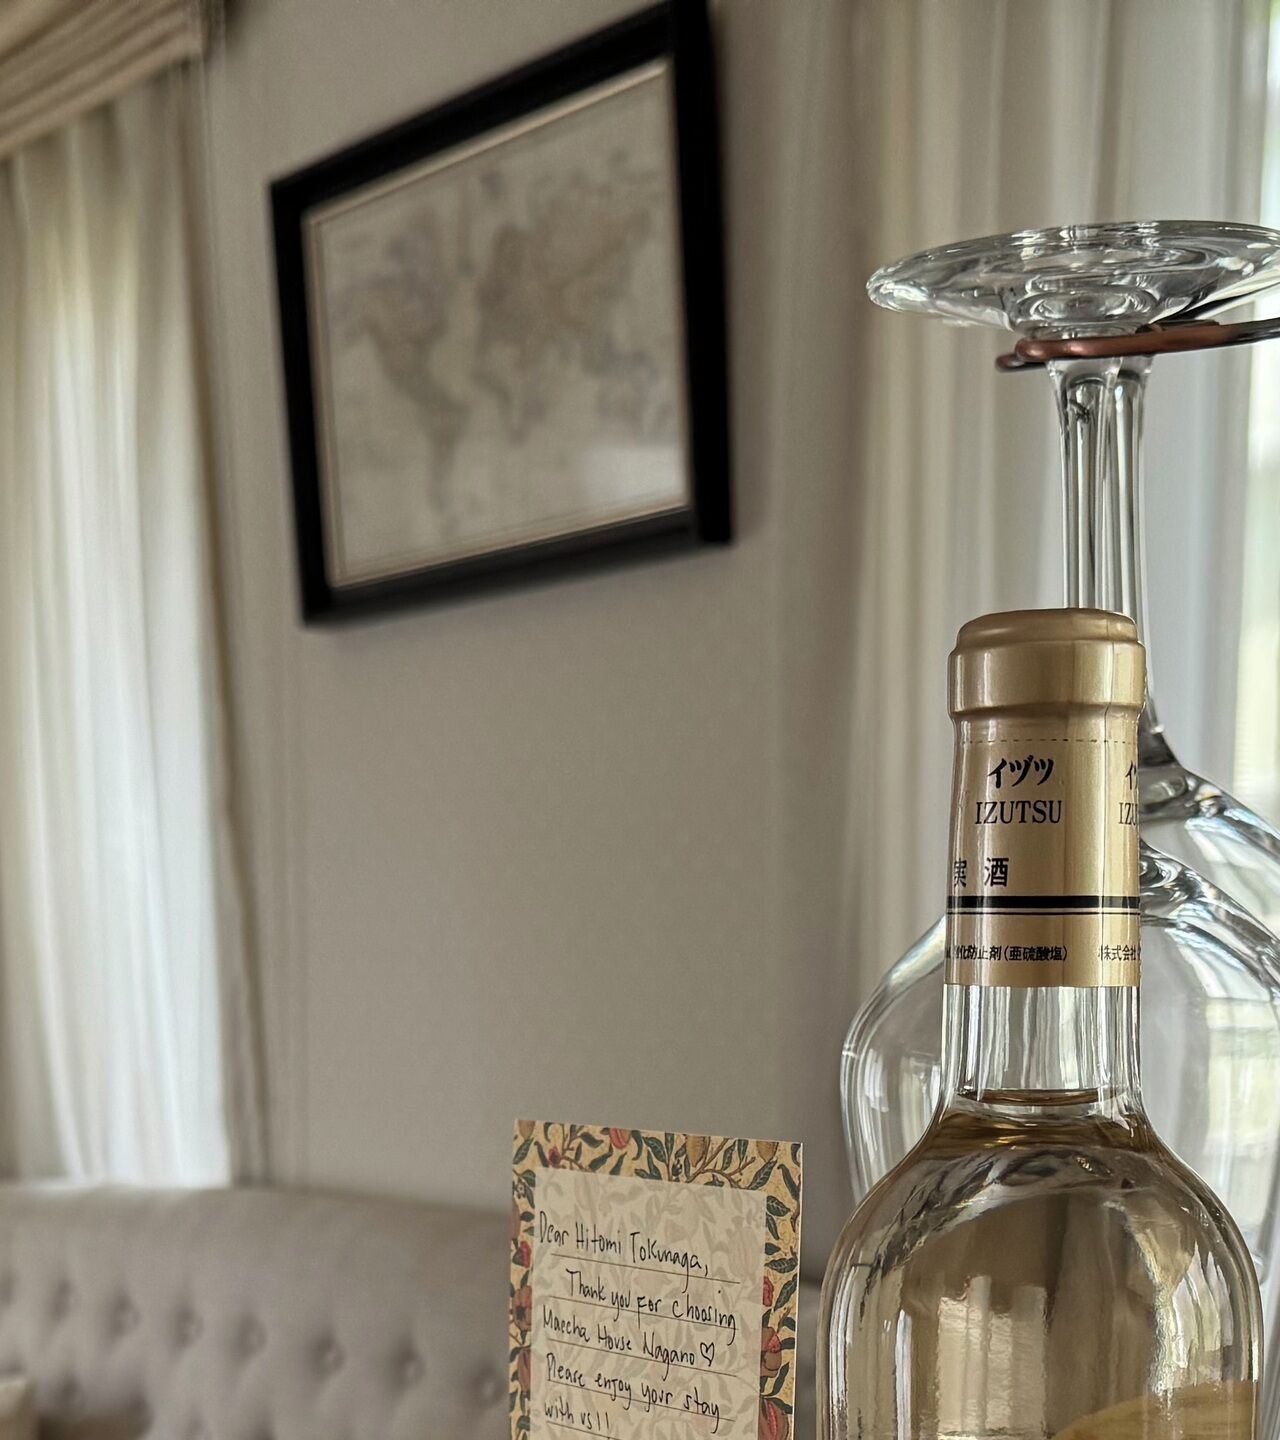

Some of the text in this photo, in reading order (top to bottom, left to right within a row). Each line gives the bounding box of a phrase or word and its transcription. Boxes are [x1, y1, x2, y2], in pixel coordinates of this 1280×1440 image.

[988, 754, 1055, 789] イヅツ
[974, 800, 1063, 825] IZUTSU
[540, 1211, 569, 1247] Dear
[575, 1221, 621, 1255] Hitomi
[565, 1268, 606, 1300] Thank
[611, 1290, 631, 1322] you
[597, 1323, 632, 1351] House
[643, 1332, 695, 1381] Nagano
[544, 1395, 575, 1424] with
[546, 1352, 585, 1387] Please
[641, 1382, 673, 1412] your
[683, 1386, 720, 1434] stay
